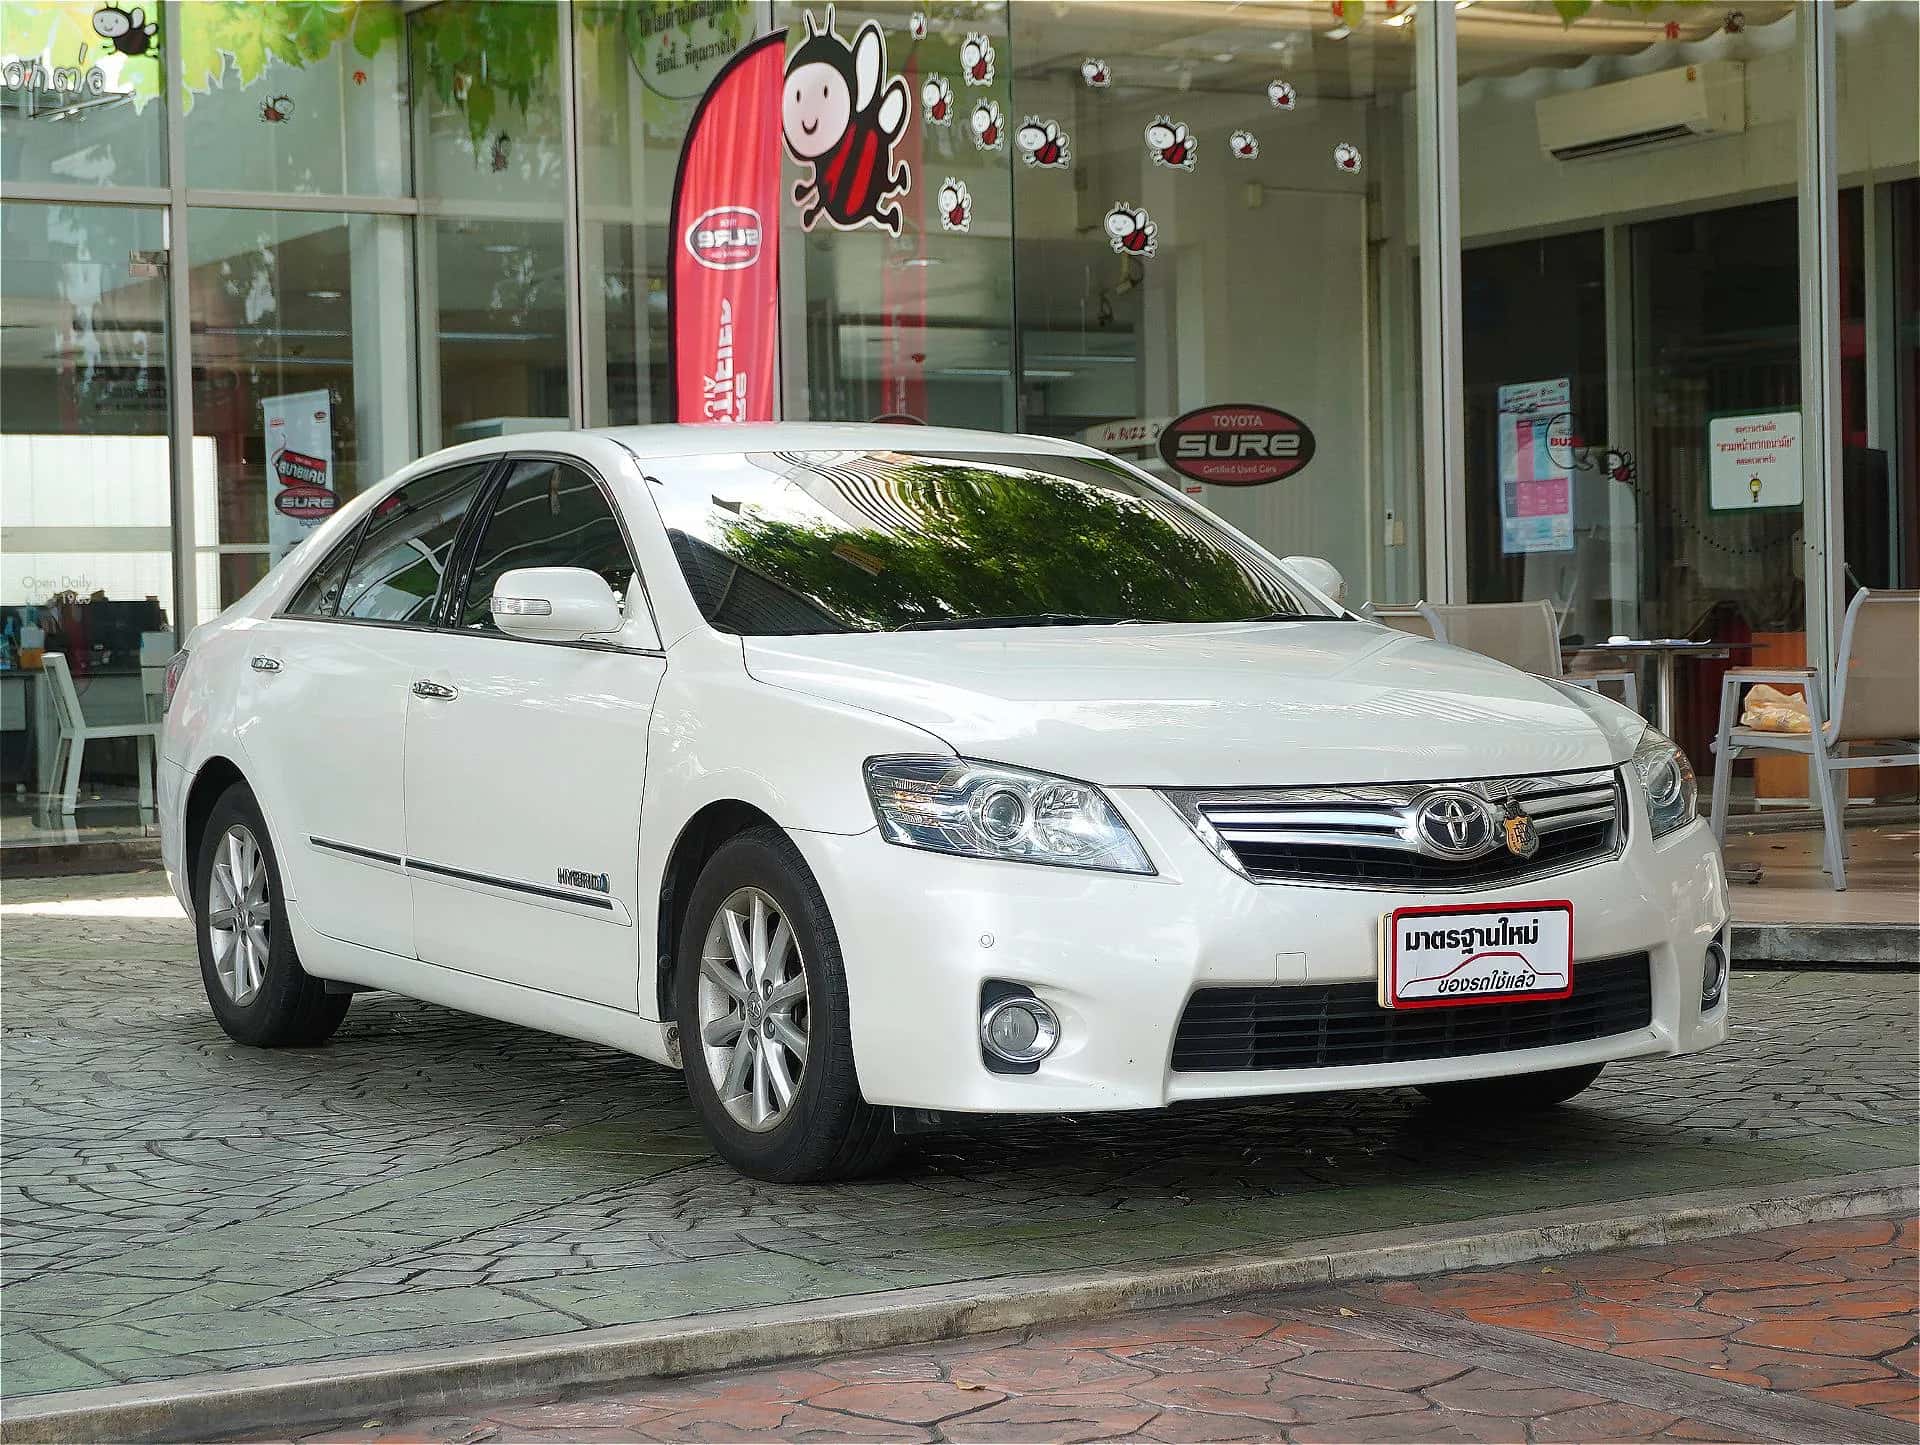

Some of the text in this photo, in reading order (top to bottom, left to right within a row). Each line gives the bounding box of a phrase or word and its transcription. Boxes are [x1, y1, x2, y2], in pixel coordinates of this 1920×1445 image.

[1212, 415, 1264, 427] TOYOTA
[1176, 434, 1301, 457] SURE
[281, 496, 336, 509] SURE
[22, 574, 91, 592] Open Daily
[1405, 917, 1539, 955] มาตรฐานใหม่
[1437, 970, 1536, 993] ของรถใช้แล้ว
